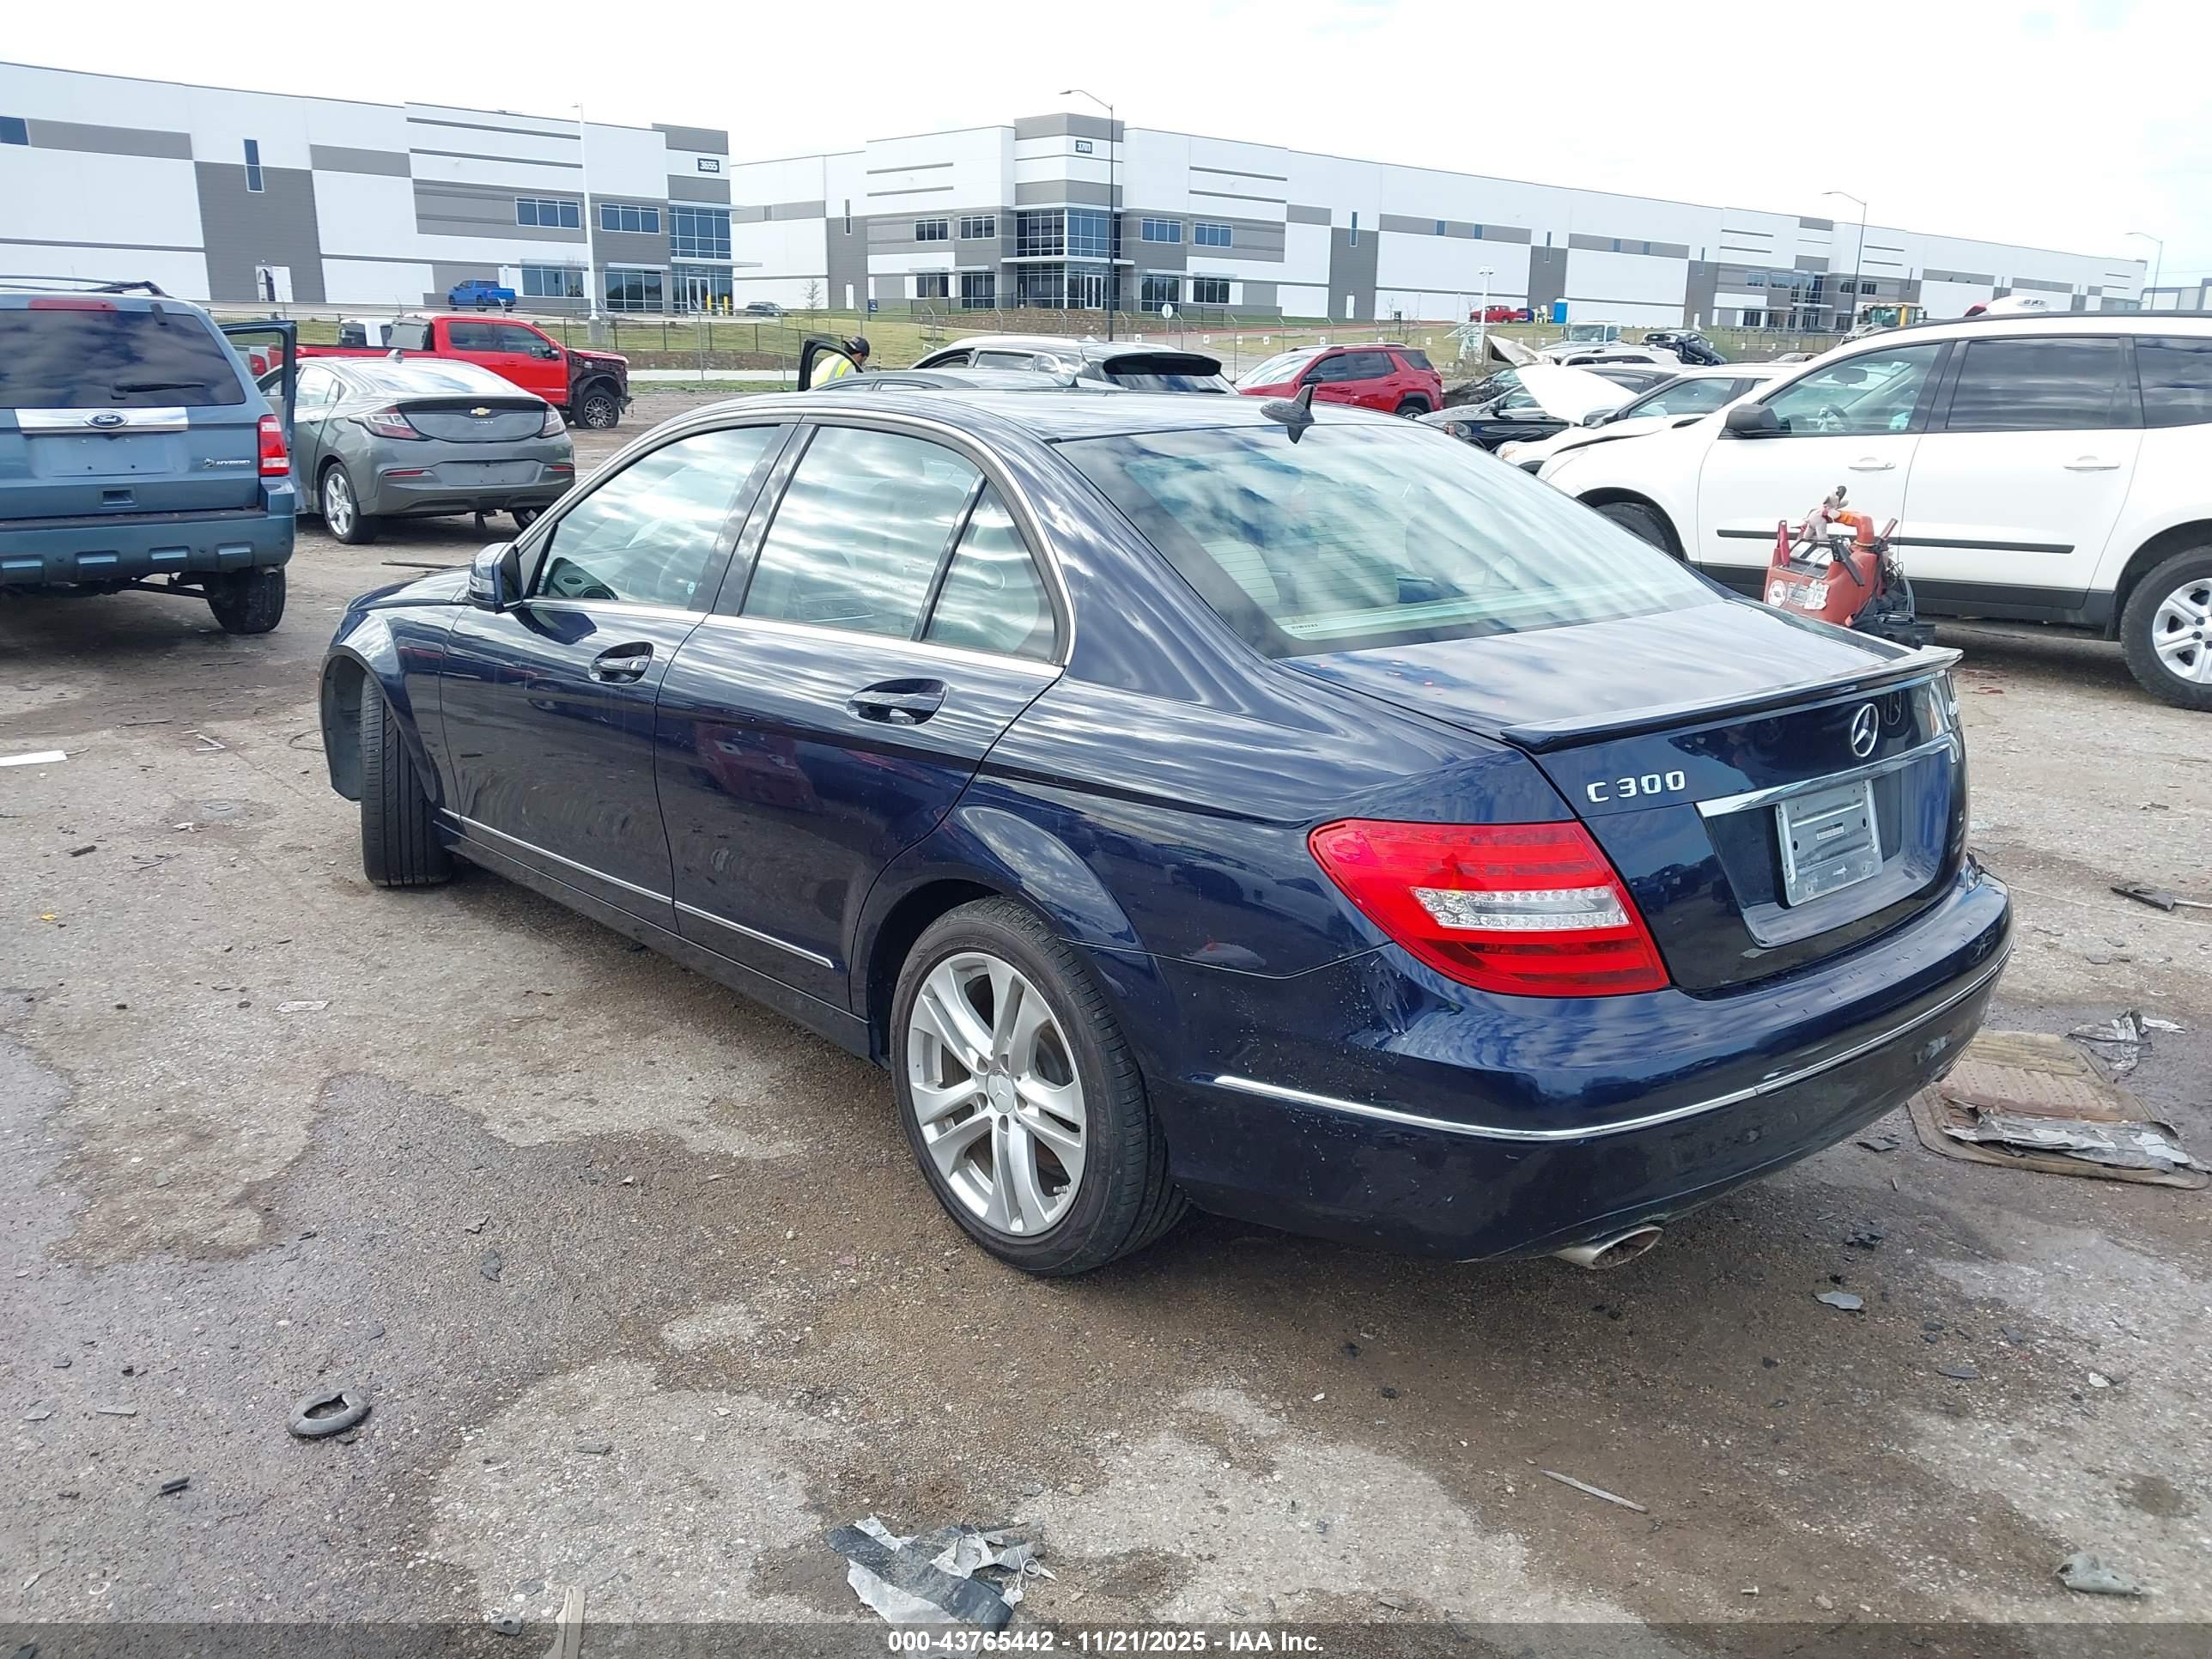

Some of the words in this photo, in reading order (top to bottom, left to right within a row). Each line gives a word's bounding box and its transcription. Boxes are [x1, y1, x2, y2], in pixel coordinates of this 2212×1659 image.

[699, 160, 718, 171] 3655
[1586, 781, 1610, 803] C
[1615, 769, 1686, 799] 300
